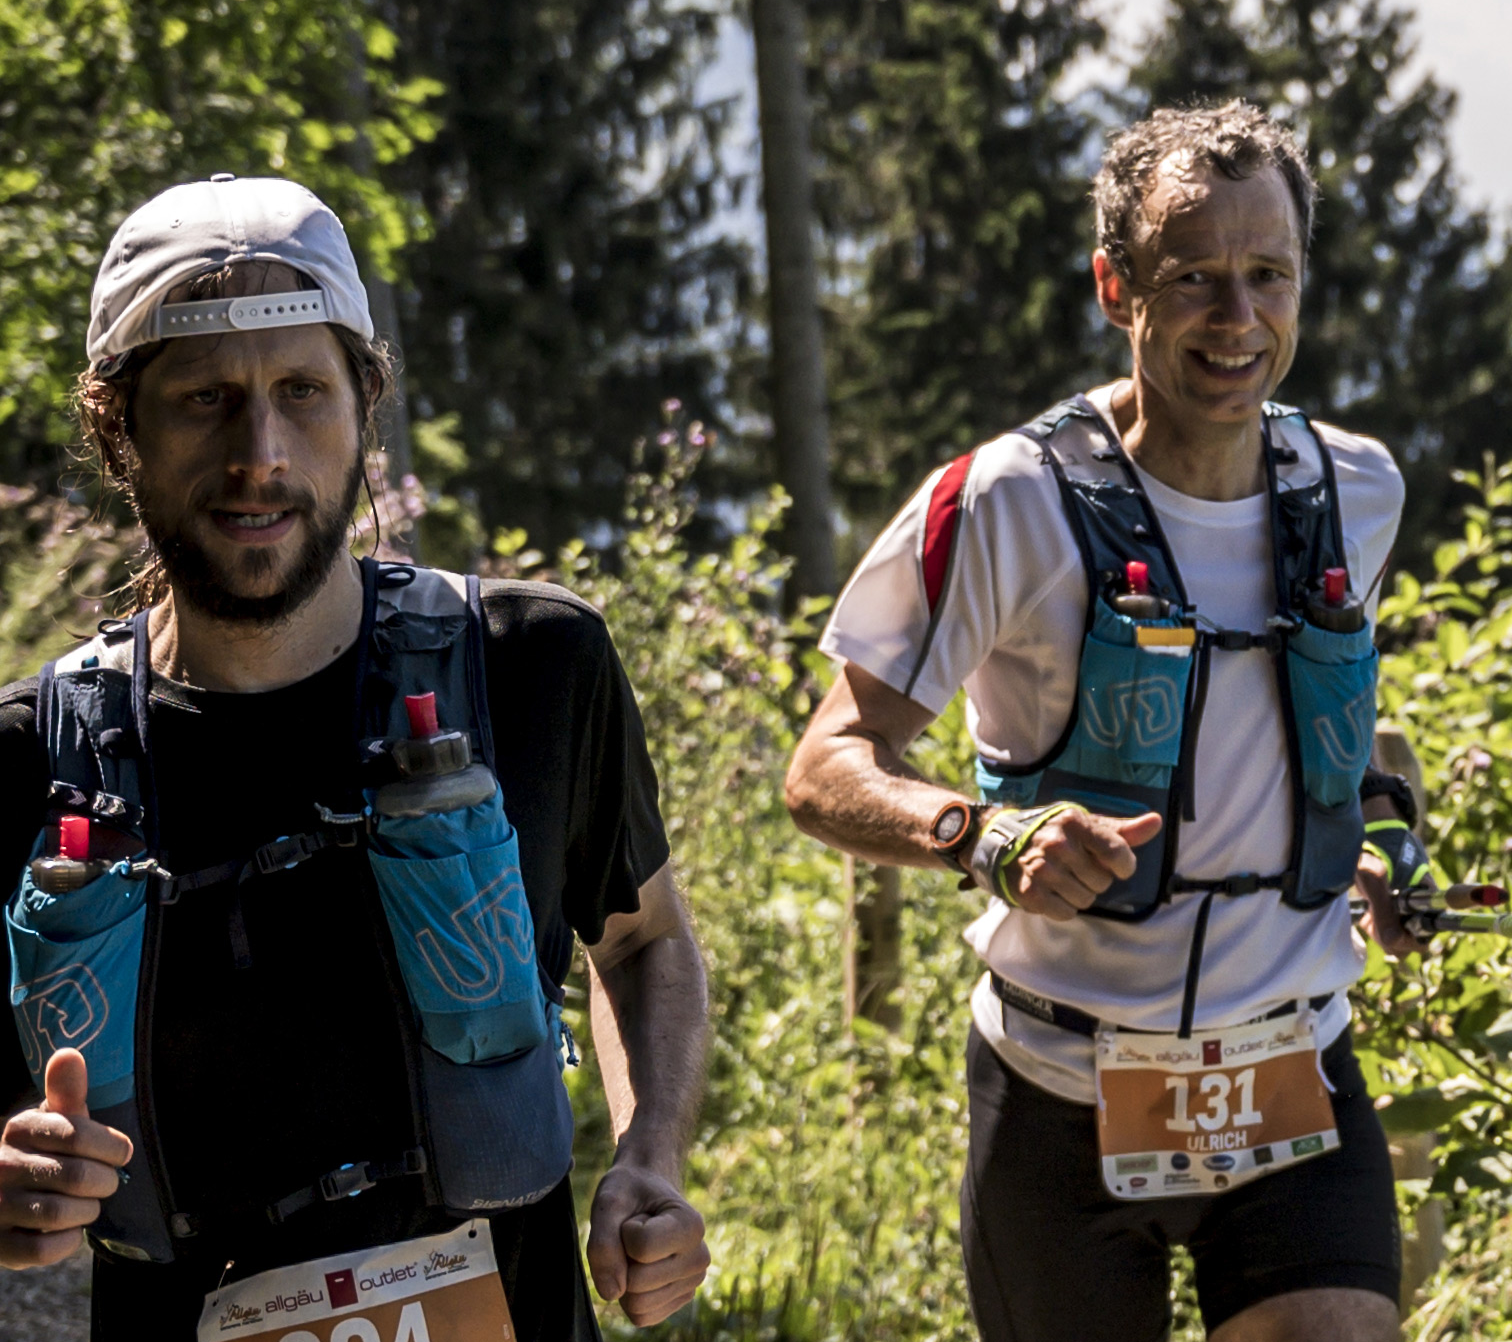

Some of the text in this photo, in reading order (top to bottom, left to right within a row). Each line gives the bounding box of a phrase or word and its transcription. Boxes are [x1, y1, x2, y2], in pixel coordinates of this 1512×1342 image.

[1164, 1067, 1263, 1132] 131
[1186, 1130, 1248, 1151] ULRICH
[265, 1263, 417, 1314] allgäu outlet
